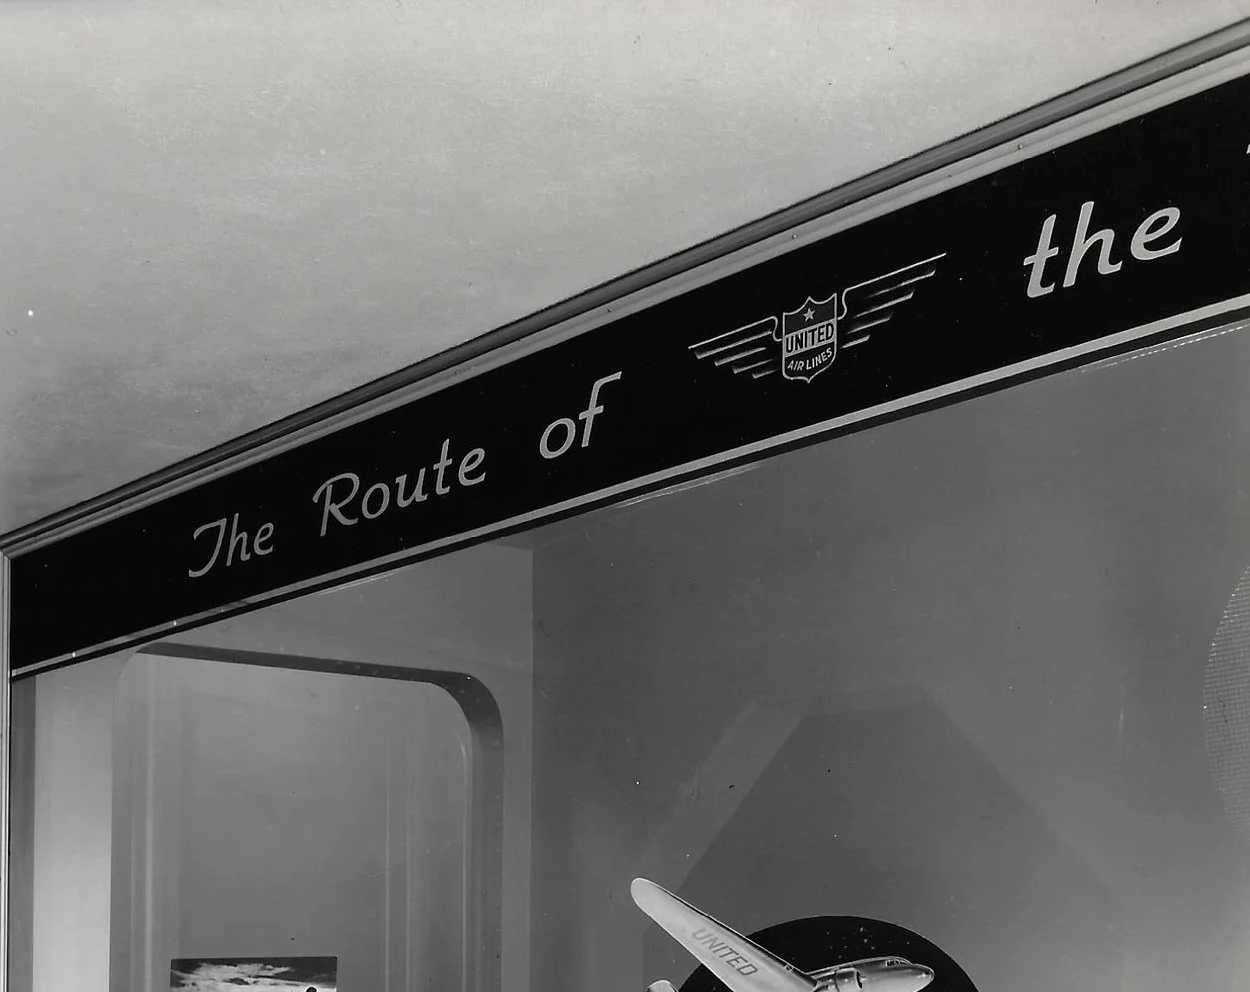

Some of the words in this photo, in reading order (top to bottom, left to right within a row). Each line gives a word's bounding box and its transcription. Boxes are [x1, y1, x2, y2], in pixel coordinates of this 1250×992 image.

[786, 322, 835, 353] UNITED
[787, 360, 805, 371] AIR
[806, 347, 833, 371] LINES
[188, 512, 275, 578] The
[312, 438, 487, 537] Route
[539, 371, 622, 459] of
[1023, 200, 1183, 298] the
[692, 928, 758, 976] UNITED
